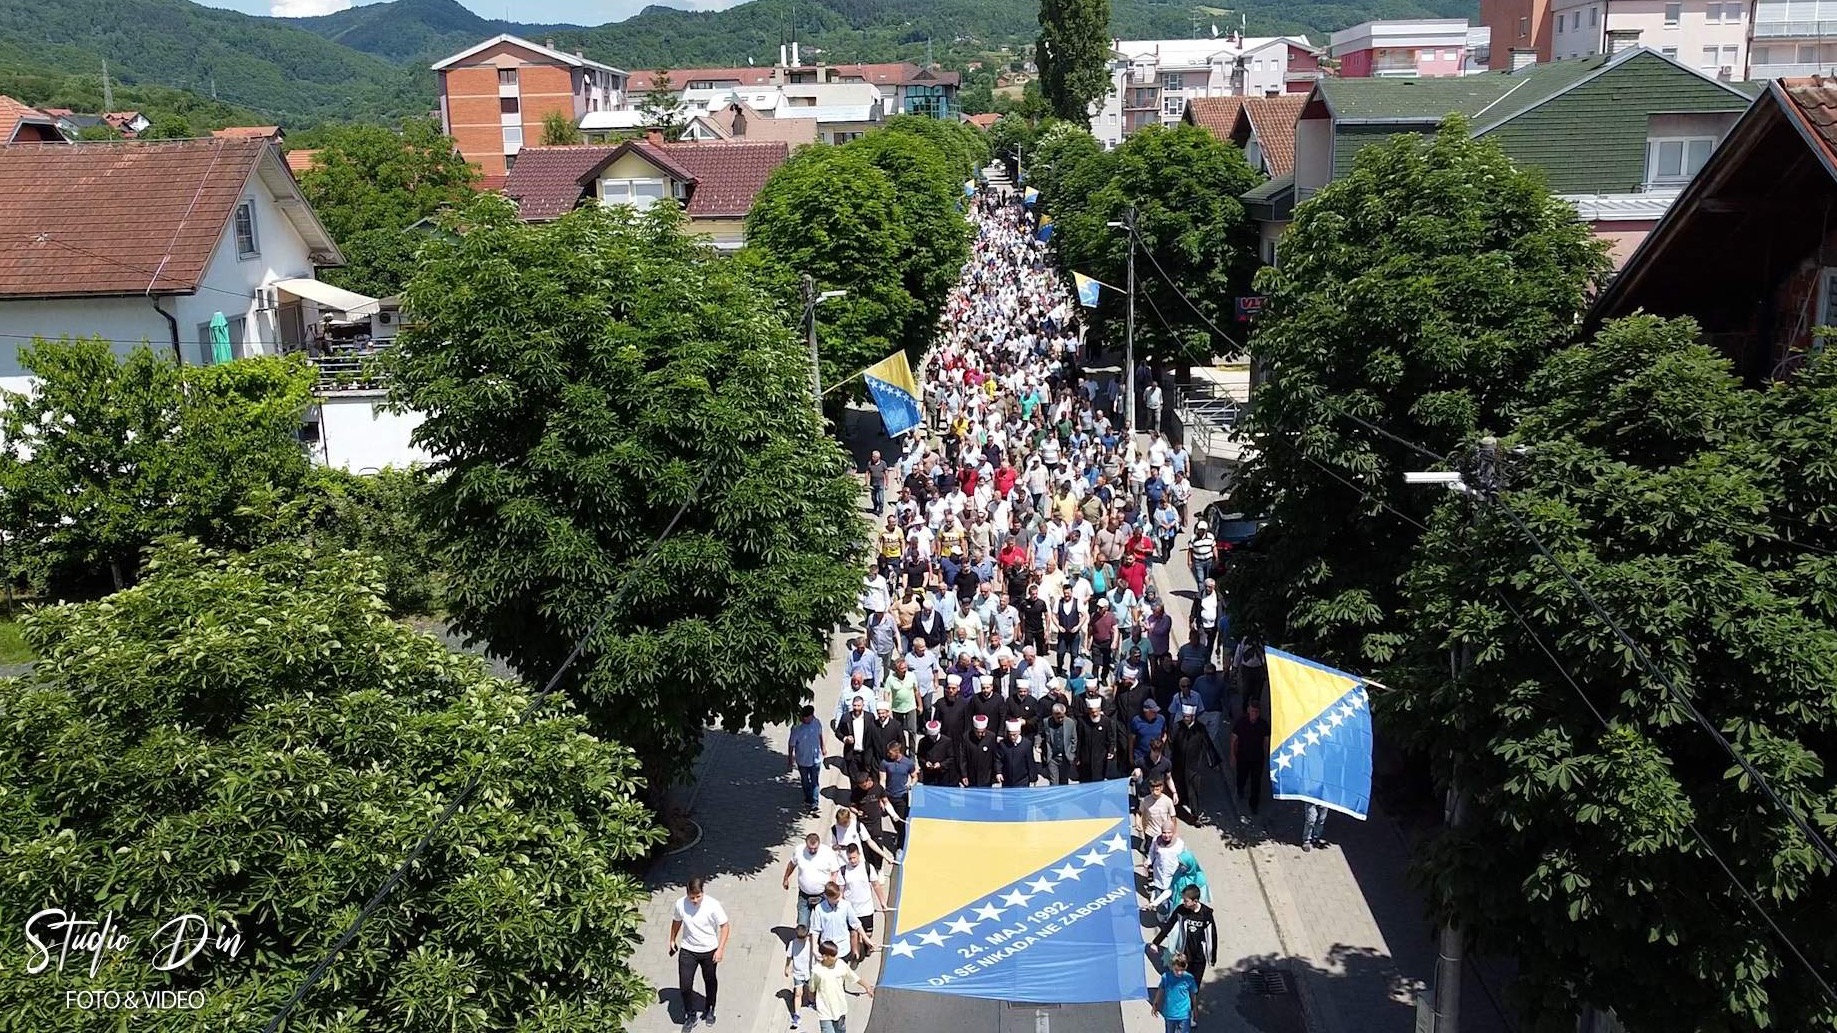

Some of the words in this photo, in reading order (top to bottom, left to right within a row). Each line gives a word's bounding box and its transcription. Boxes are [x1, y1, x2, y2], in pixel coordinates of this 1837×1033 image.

[928, 974, 957, 987] DA
[955, 963, 980, 977] SE
[980, 935, 1039, 968] NIKADA
[1040, 924, 1062, 938] NE
[1059, 886, 1132, 926] ZABORAVI
[958, 943, 989, 959] 24.
[985, 922, 1029, 945] MAJ
[1027, 901, 1074, 924] 1992.
